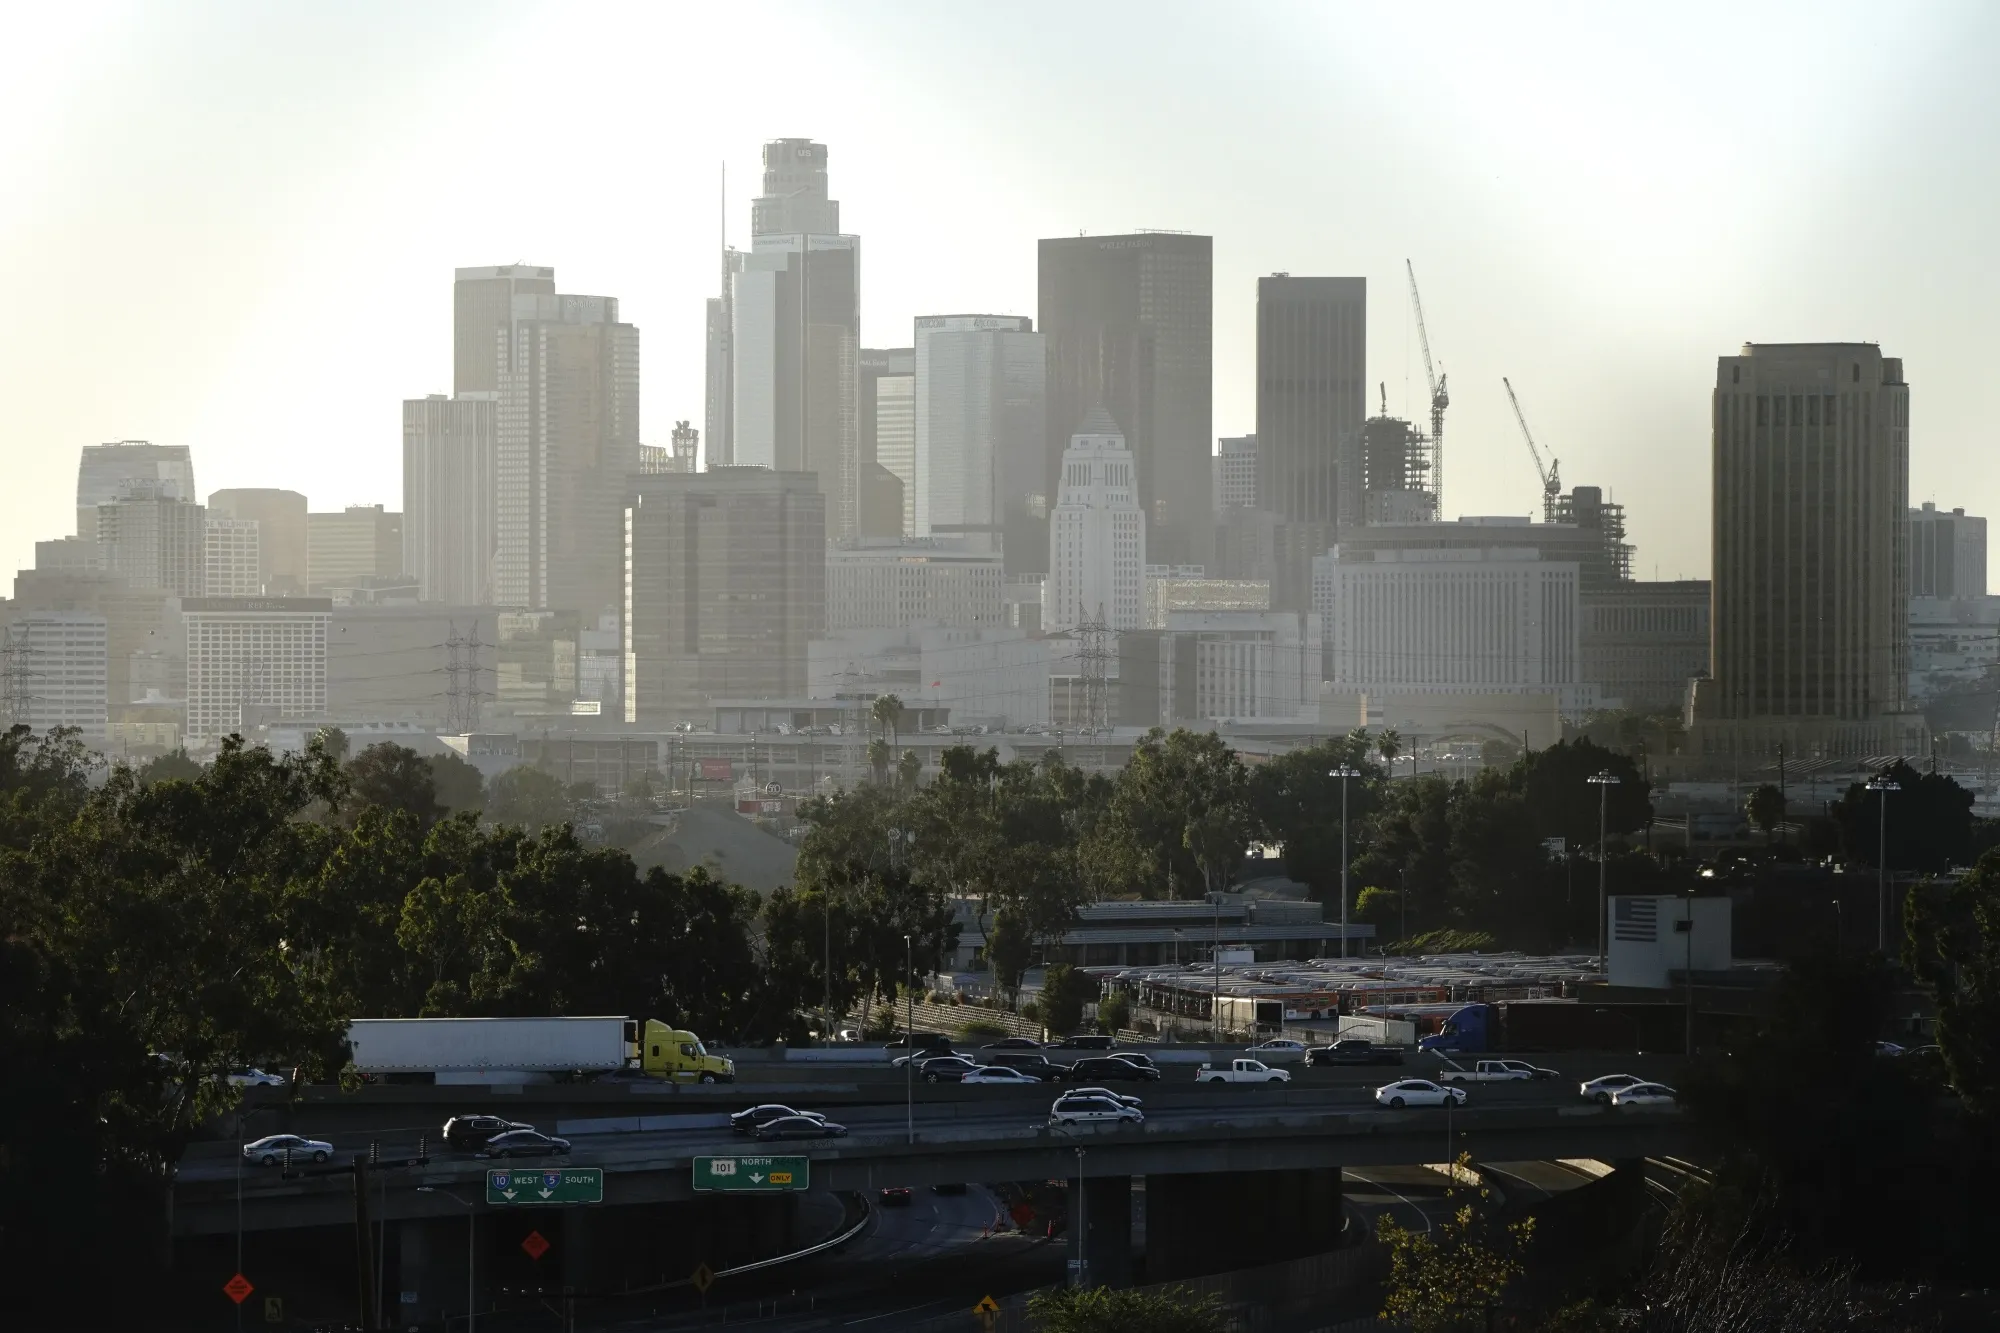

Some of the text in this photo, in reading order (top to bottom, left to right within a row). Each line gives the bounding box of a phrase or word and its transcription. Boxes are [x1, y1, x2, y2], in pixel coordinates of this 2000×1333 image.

[716, 1163, 731, 1172] 101
[741, 1158, 772, 1166] NORTH
[496, 1175, 594, 1185] 10 WEST 5 SOUTH
